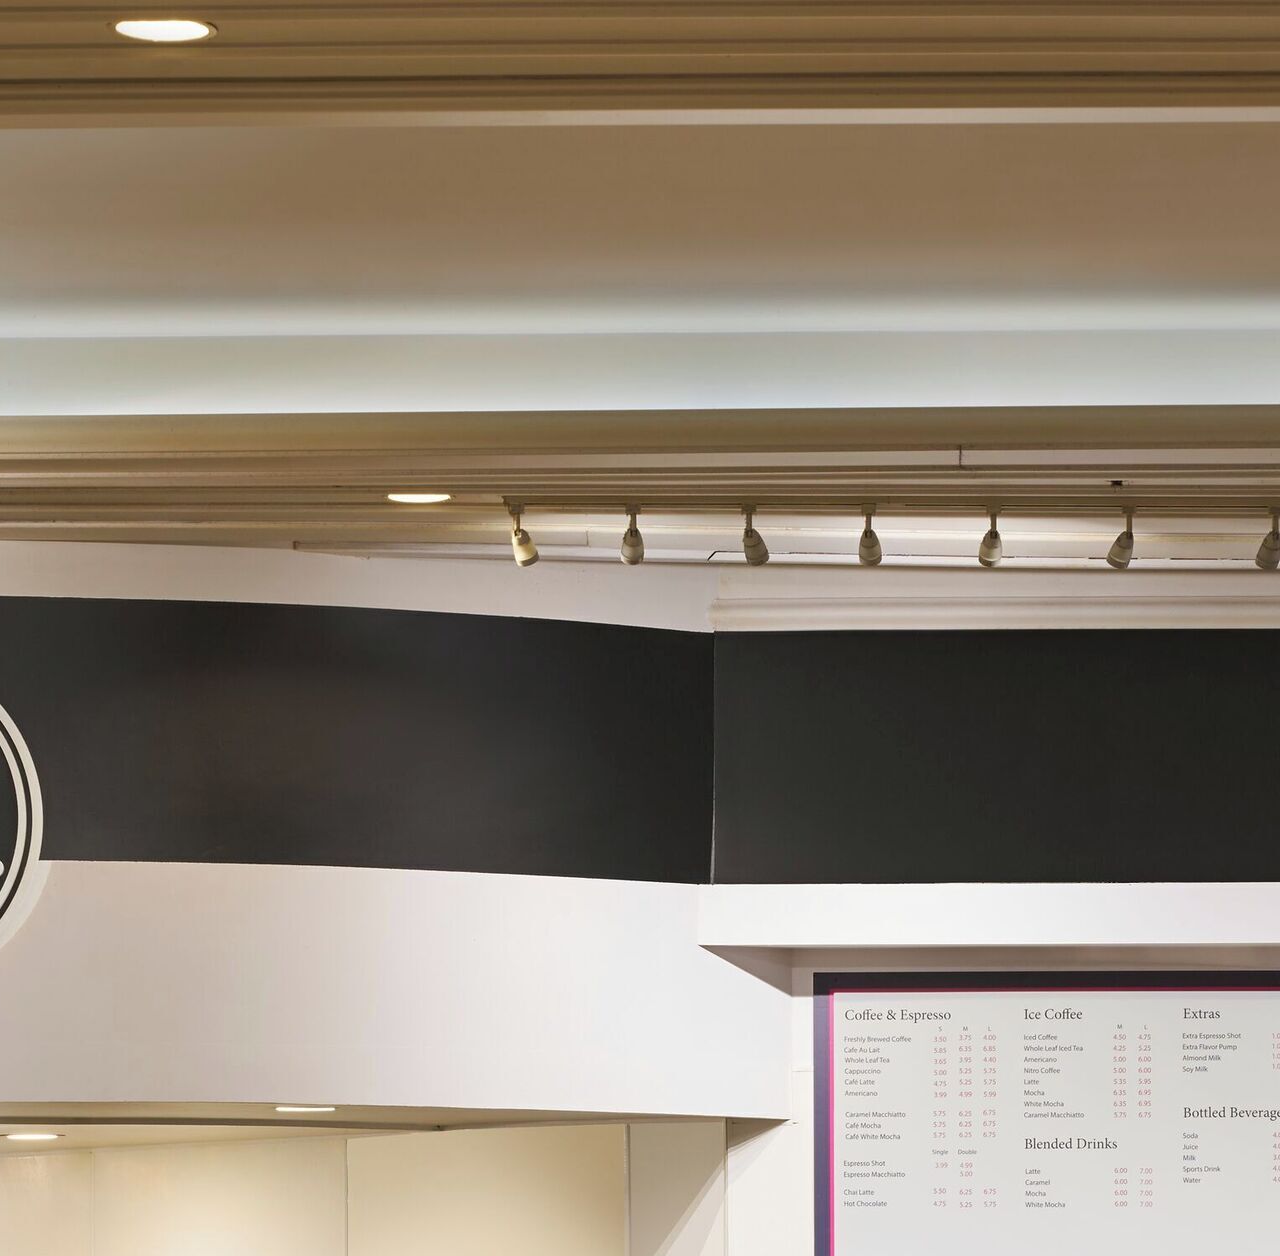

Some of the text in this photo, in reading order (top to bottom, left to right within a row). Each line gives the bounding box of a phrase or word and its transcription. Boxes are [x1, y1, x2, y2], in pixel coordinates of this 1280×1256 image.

[845, 1009, 951, 1024] Coffee & Espresso
[1024, 1008, 1083, 1020] Ice Coffee
[1184, 1008, 1220, 1019] Extras
[844, 1034, 912, 1044] Freshly Brewed Coffee
[1199, 1032, 1226, 1040] Espresso
[1218, 1043, 1237, 1051] Pump
[865, 1056, 879, 1064] Leaf
[844, 1068, 882, 1076] Cappuccino
[1182, 1065, 1194, 1074] Soy
[844, 1089, 878, 1097] Americano
[1184, 1106, 1226, 1118] Bottled
[1025, 1137, 1118, 1149] Blended Drinks
